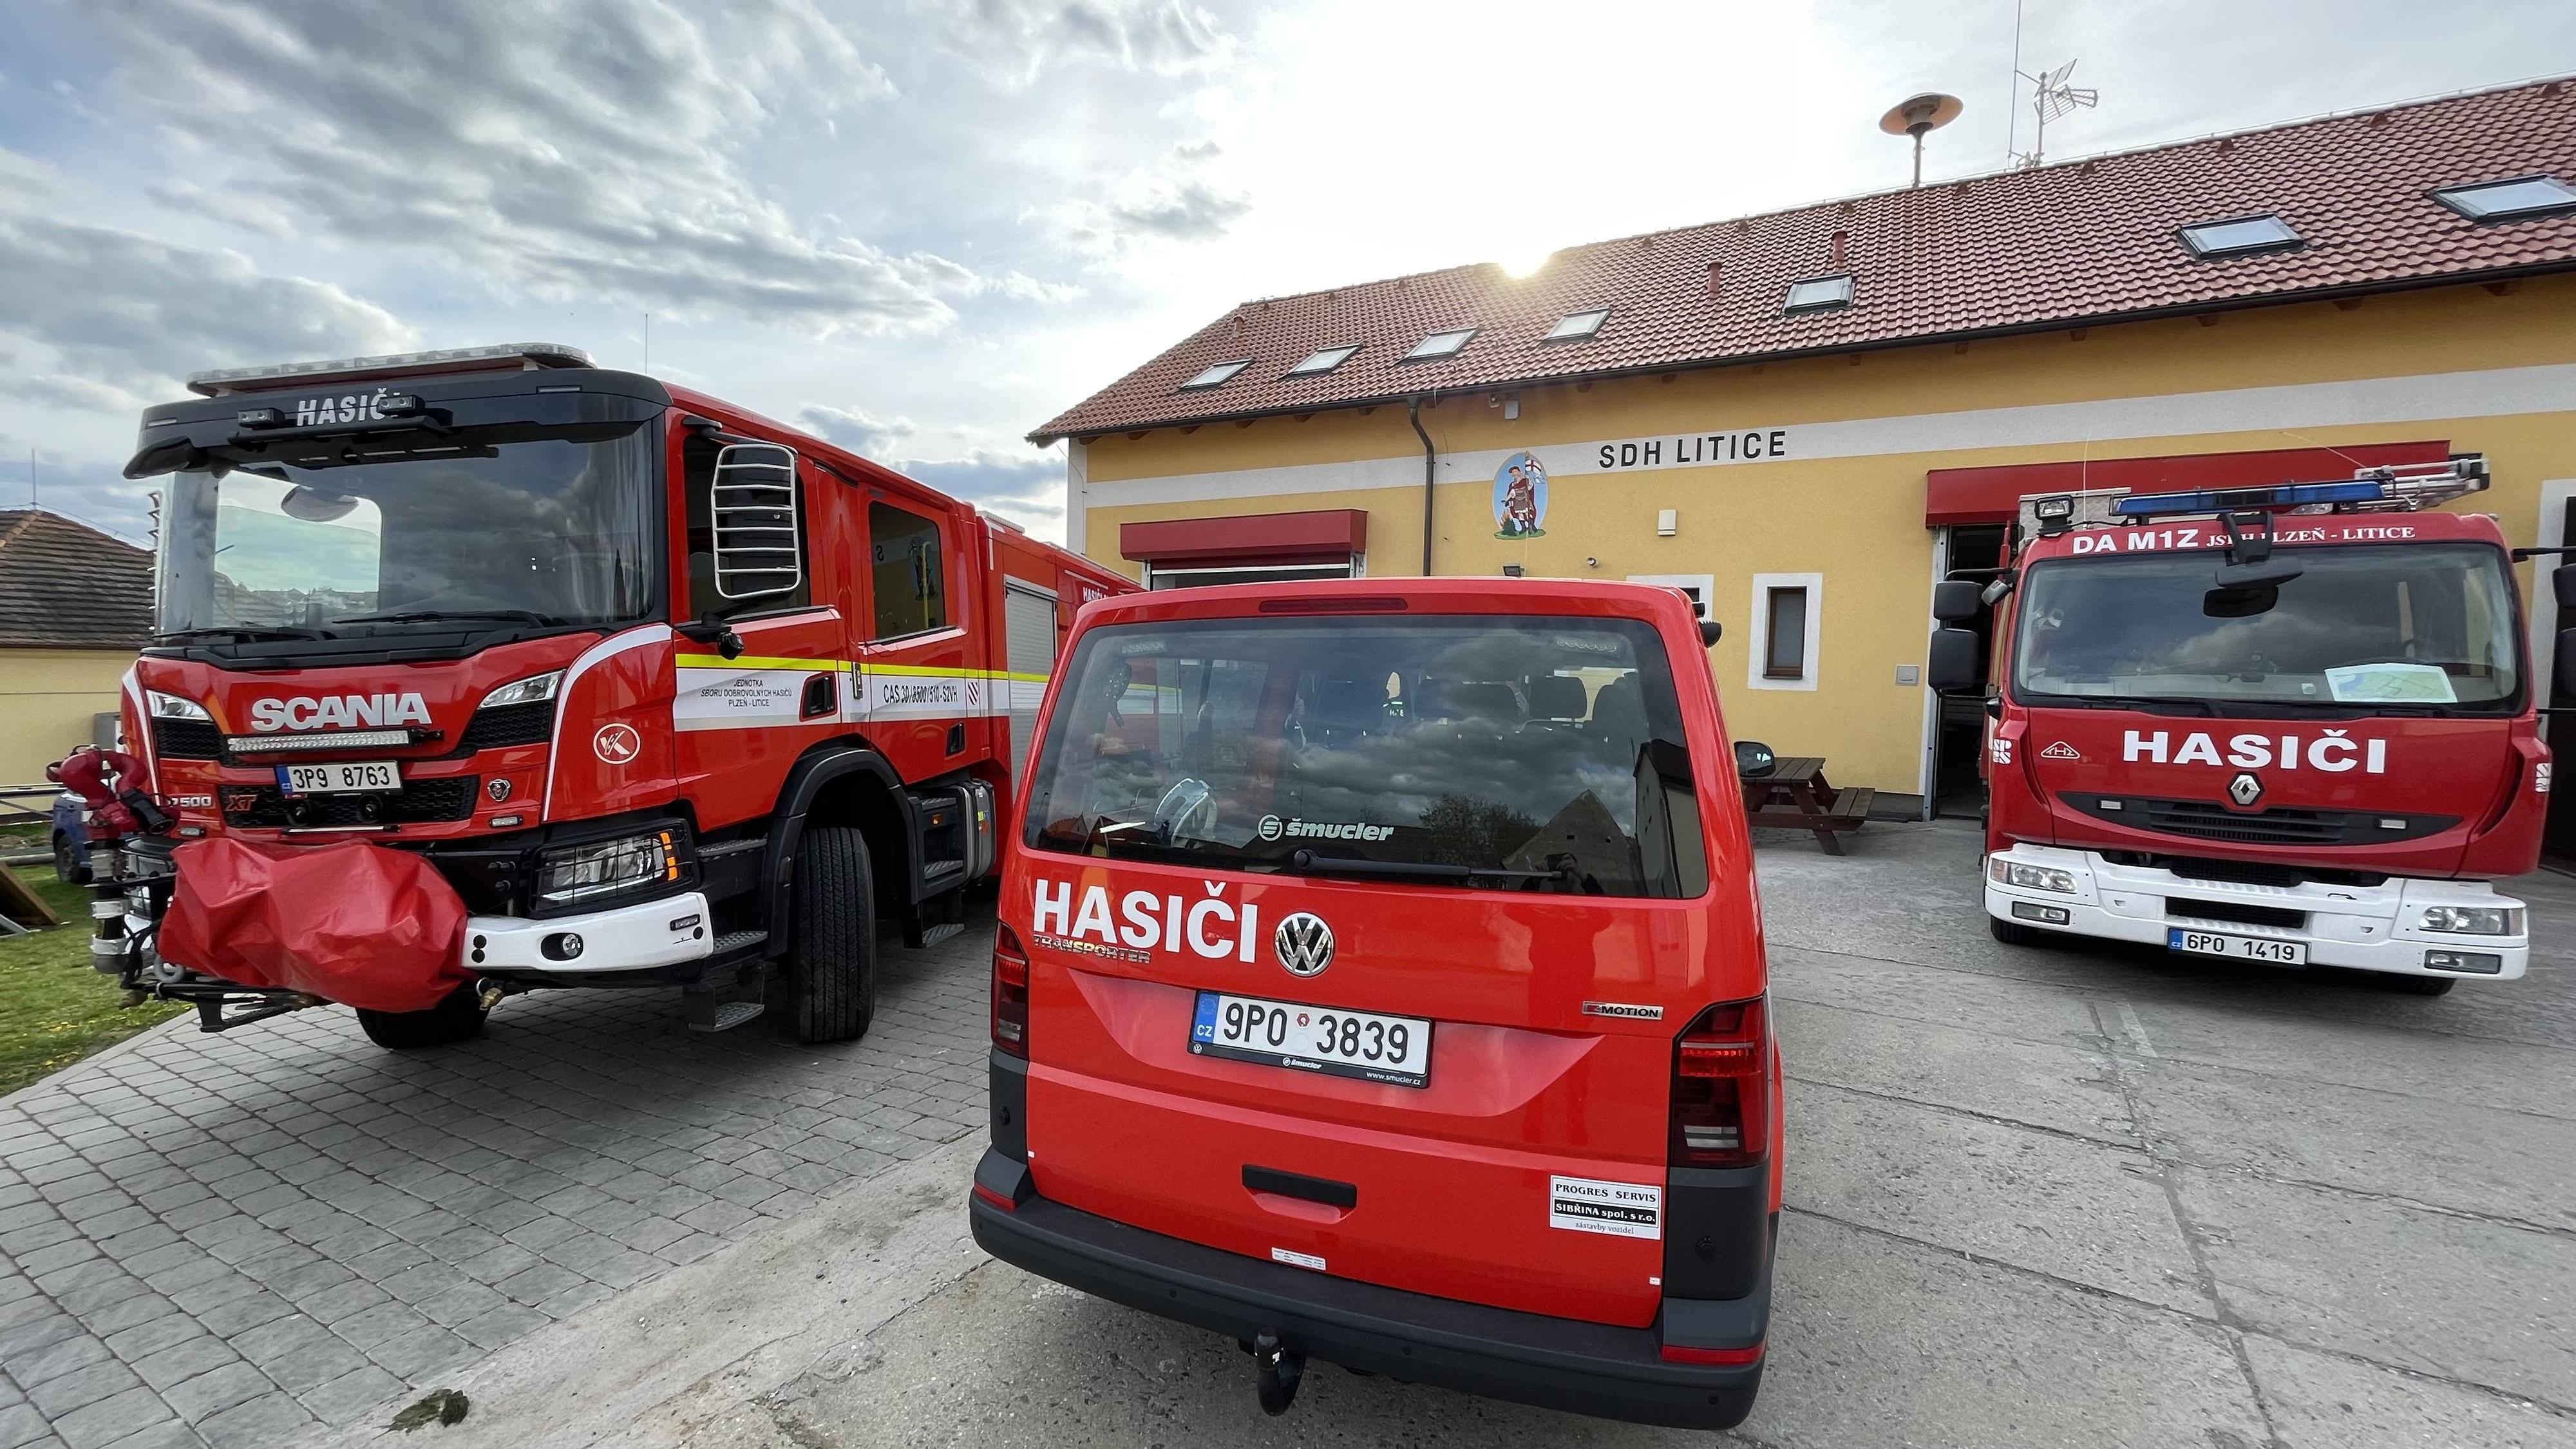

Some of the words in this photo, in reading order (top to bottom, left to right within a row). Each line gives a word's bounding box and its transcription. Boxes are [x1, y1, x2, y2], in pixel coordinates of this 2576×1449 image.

[296, 388, 401, 426] HASIČ
[1599, 440, 1661, 468] SDH
[1676, 431, 1786, 463] LITICE
[2072, 534, 2117, 554] DA
[2127, 529, 2199, 551] M1Z
[2260, 527, 2325, 543] LZEŇ
[2342, 527, 2416, 541] LITICE
[700, 688, 723, 697] SBORU
[734, 679, 764, 687] JEDNOTKA
[884, 685, 900, 703] CAS
[251, 692, 432, 732] SCANIA
[728, 697, 748, 707] PLZEŇ
[752, 699, 770, 707] LITICE
[2123, 728, 2386, 773] HASIČI
[292, 768, 328, 789] 3P9
[342, 766, 391, 787] 8763
[1285, 818, 1395, 841] šmucler
[1033, 878, 1258, 964] HASIČI
[1033, 934, 1151, 964] TRANSPORTER
[2187, 934, 2224, 952] 6P0
[2244, 941, 2295, 961] 1419
[1197, 1025, 1213, 1037] CZ
[1224, 1003, 1287, 1046] 9P0
[1316, 1015, 1408, 1063] 3839
[1366, 1071, 1421, 1085] www.smucler.cz
[1555, 1184, 1609, 1197] PROGRES
[1615, 1191, 1656, 1202] SERVIS
[1555, 1203, 1600, 1216] SIBŘINA
[1601, 1209, 1627, 1220] spol.
[1575, 1222, 1607, 1232] zástavby
[1608, 1226, 1634, 1235] vozidel
